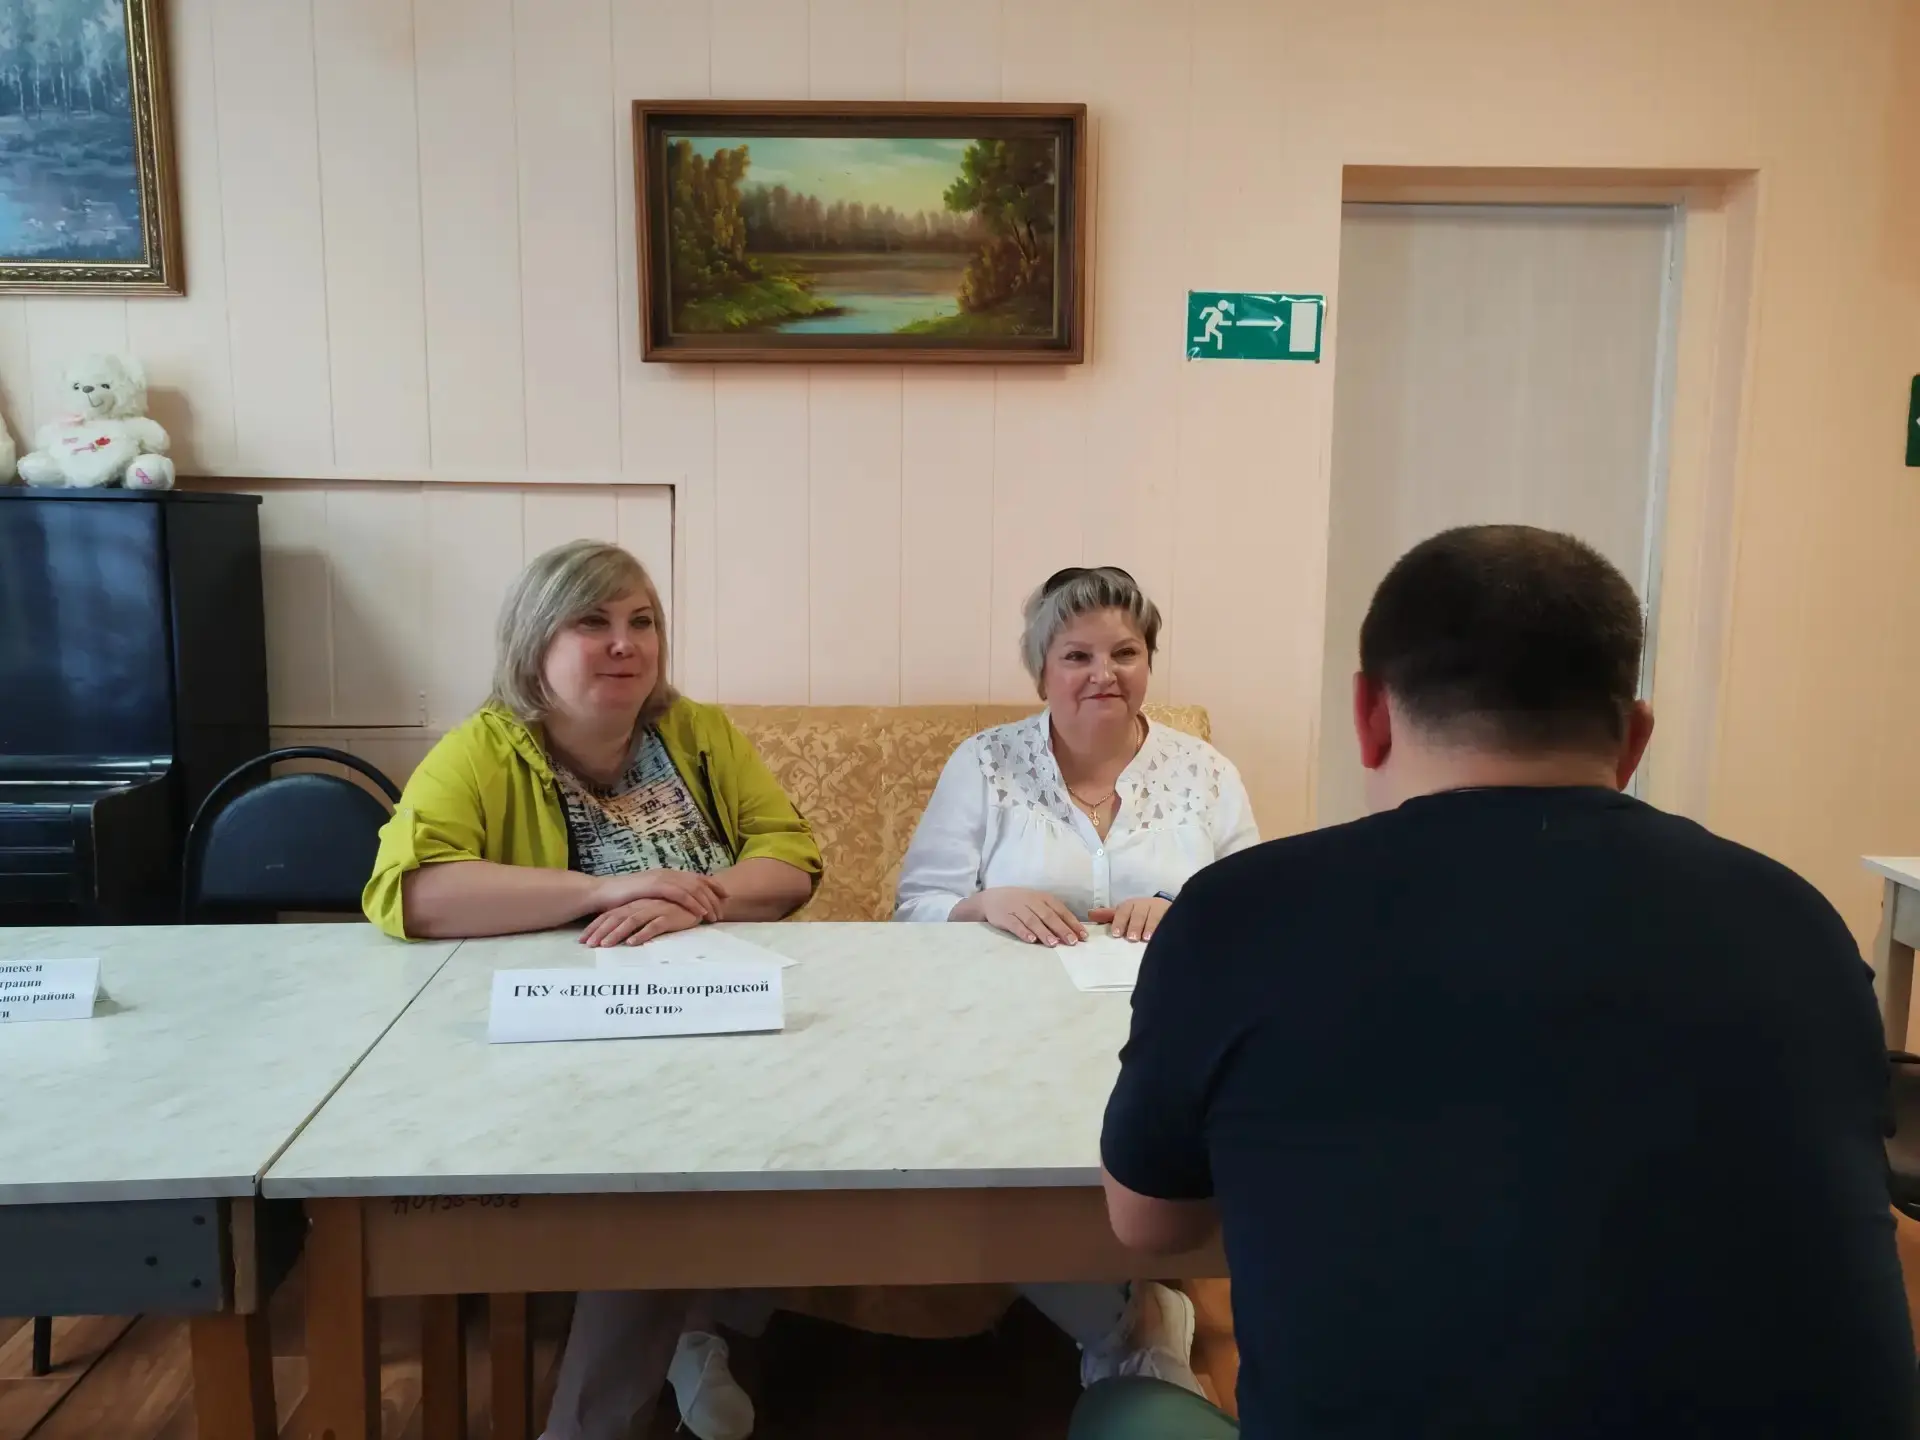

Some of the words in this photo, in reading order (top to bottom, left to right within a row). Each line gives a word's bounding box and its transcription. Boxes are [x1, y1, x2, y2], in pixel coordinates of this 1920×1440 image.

[35, 964, 43, 972] и
[514, 985, 554, 997] ГКУ
[560, 983, 640, 998] «ЕЦСПН
[647, 981, 769, 997] Волгоградской
[32, 992, 75, 1004] района
[605, 1003, 683, 1015] области»
